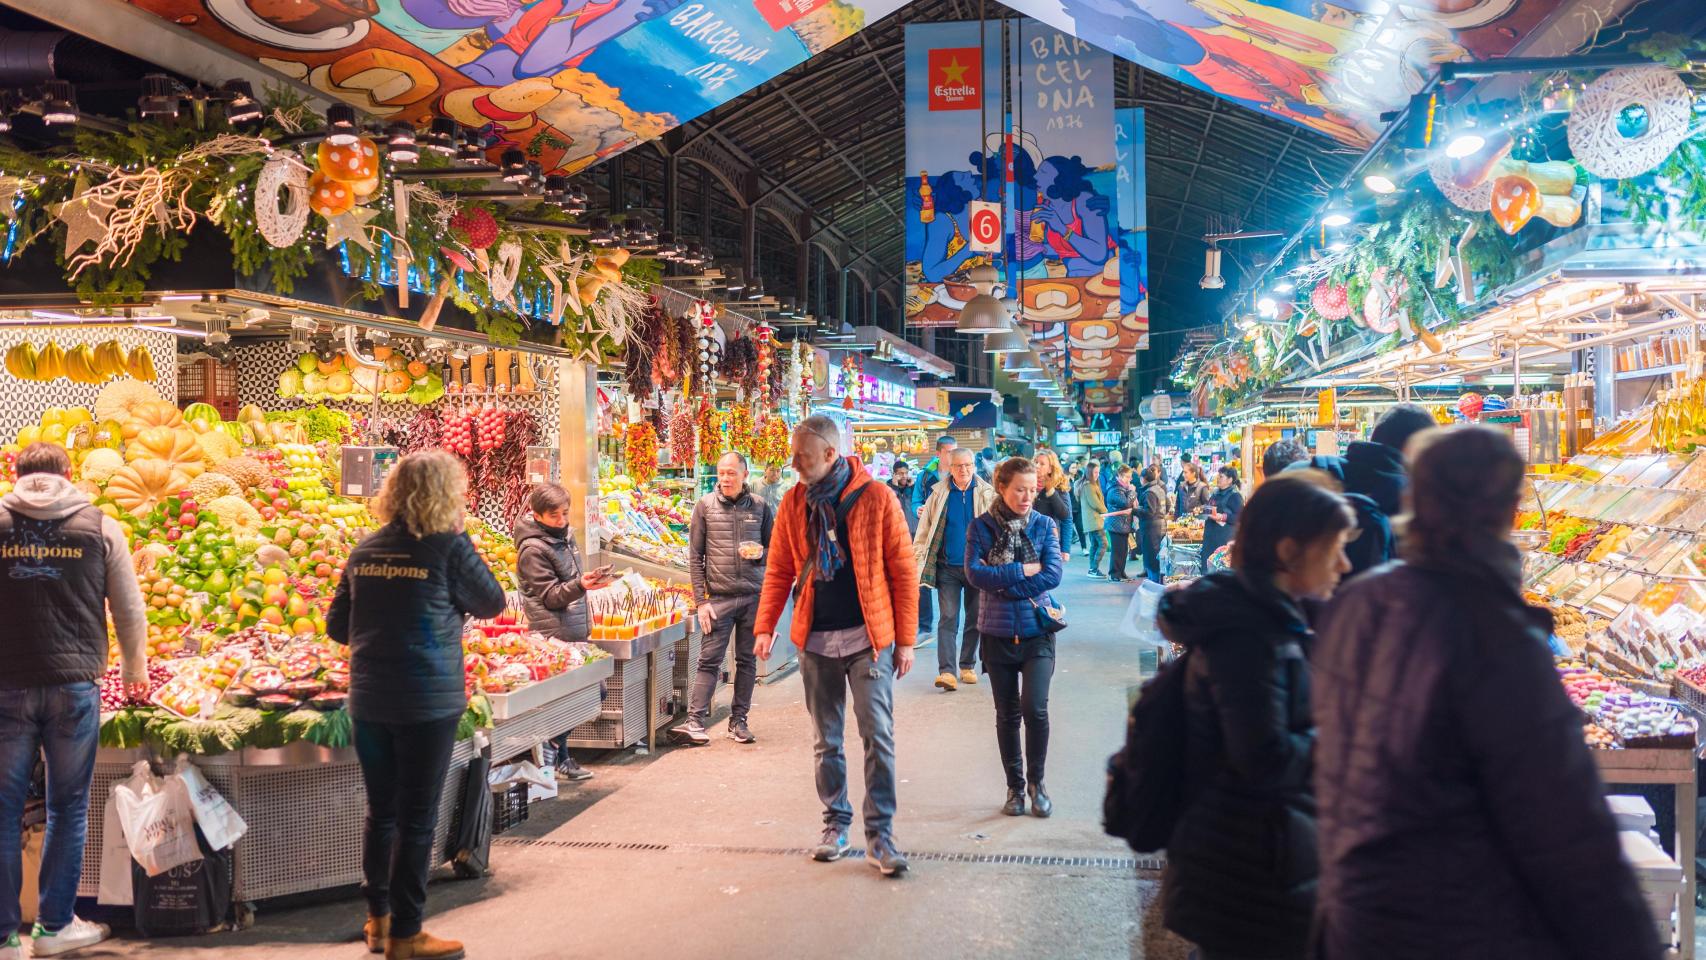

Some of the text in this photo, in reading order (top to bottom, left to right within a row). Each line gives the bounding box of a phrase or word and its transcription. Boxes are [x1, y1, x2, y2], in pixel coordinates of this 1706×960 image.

[1030, 33, 1091, 59] BAR
[1036, 59, 1092, 85] CEL
[934, 85, 976, 97] Estrella
[1037, 85, 1095, 112] ONA
[1046, 114, 1083, 132] 1876
[980, 215, 993, 239] 6
[0, 543, 83, 560] idalpons
